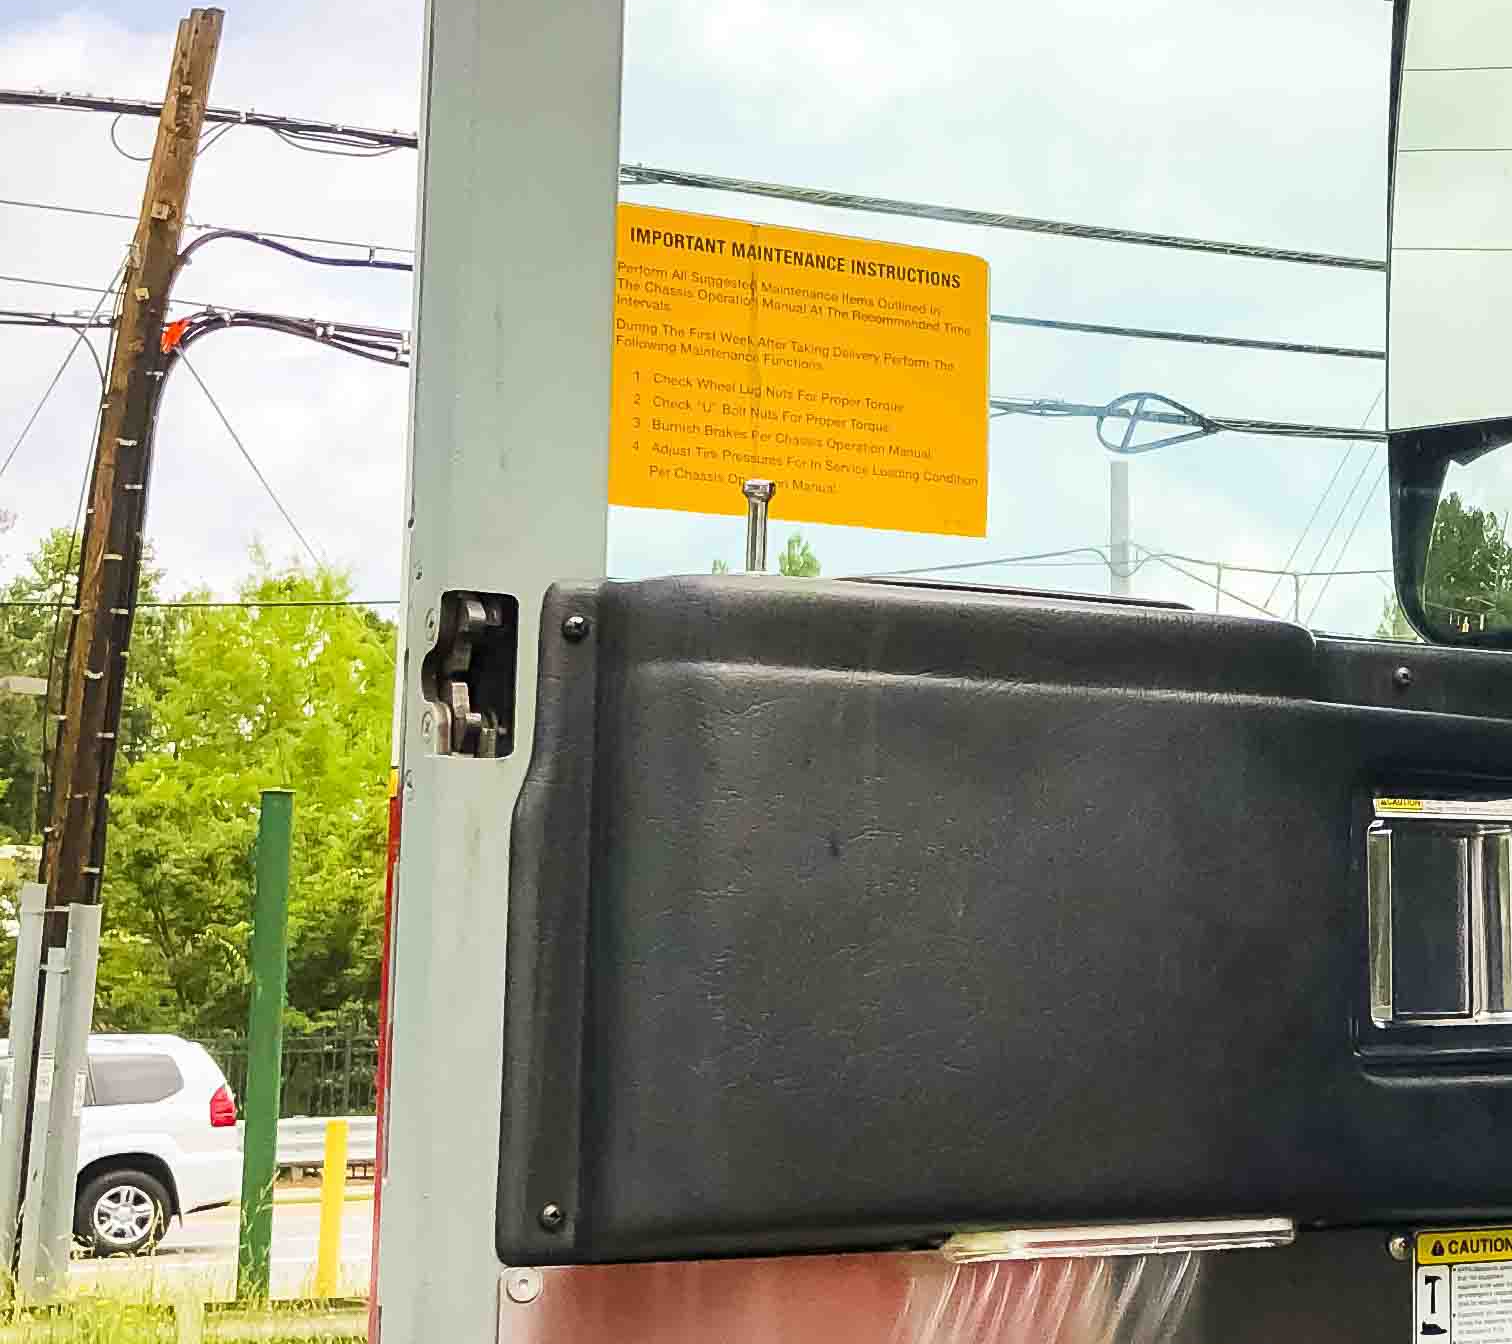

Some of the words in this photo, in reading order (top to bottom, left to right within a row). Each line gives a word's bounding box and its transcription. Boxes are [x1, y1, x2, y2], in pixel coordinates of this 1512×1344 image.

[631, 227, 726, 255] IMPORTANT
[732, 241, 845, 273] MAINTENANCE
[851, 259, 961, 289] INSTRUCTIONS
[617, 261, 667, 277] Perform
[672, 269, 687, 281] All
[691, 272, 758, 291] Suggested
[761, 280, 839, 302] Maintenance
[842, 293, 874, 308] Items
[878, 297, 927, 314] Outlined
[617, 278, 640, 291] The
[645, 281, 694, 298] Chassis
[698, 289, 758, 307] Operation
[762, 297, 806, 314] Manual
[810, 304, 823, 316] At
[827, 307, 849, 319] The
[852, 311, 940, 332] Recommended
[944, 322, 970, 337] Time
[616, 318, 657, 337] During
[662, 324, 685, 337] The
[690, 328, 716, 341] First
[720, 332, 752, 345] Week
[758, 336, 786, 351] After
[791, 341, 829, 359] Taking
[832, 346, 881, 365] Delivery
[884, 352, 930, 368] Perform
[934, 359, 954, 371] The
[616, 335, 676, 354] Following
[680, 343, 759, 363] Maintenance
[653, 373, 693, 389] Check
[697, 377, 735, 393] Wheel
[739, 384, 761, 399] Lug
[766, 385, 793, 401] Nuts
[798, 389, 817, 402] For
[821, 392, 860, 408] Proper
[653, 395, 691, 410] Check
[722, 404, 746, 417] Bolt
[751, 407, 778, 421] Nuts
[782, 410, 802, 424] For
[806, 413, 847, 429] Proper
[652, 418, 700, 434] Burnish
[704, 424, 748, 440] Brakes
[752, 430, 771, 443] Per
[775, 433, 823, 448] Chassis
[826, 437, 885, 456] Operation
[649, 465, 670, 477] Per
[675, 467, 721, 483] Chassis
[651, 441, 691, 457] Adjust
[722, 449, 783, 467] Pressures
[786, 455, 807, 468] For
[924, 471, 978, 487] Condition
